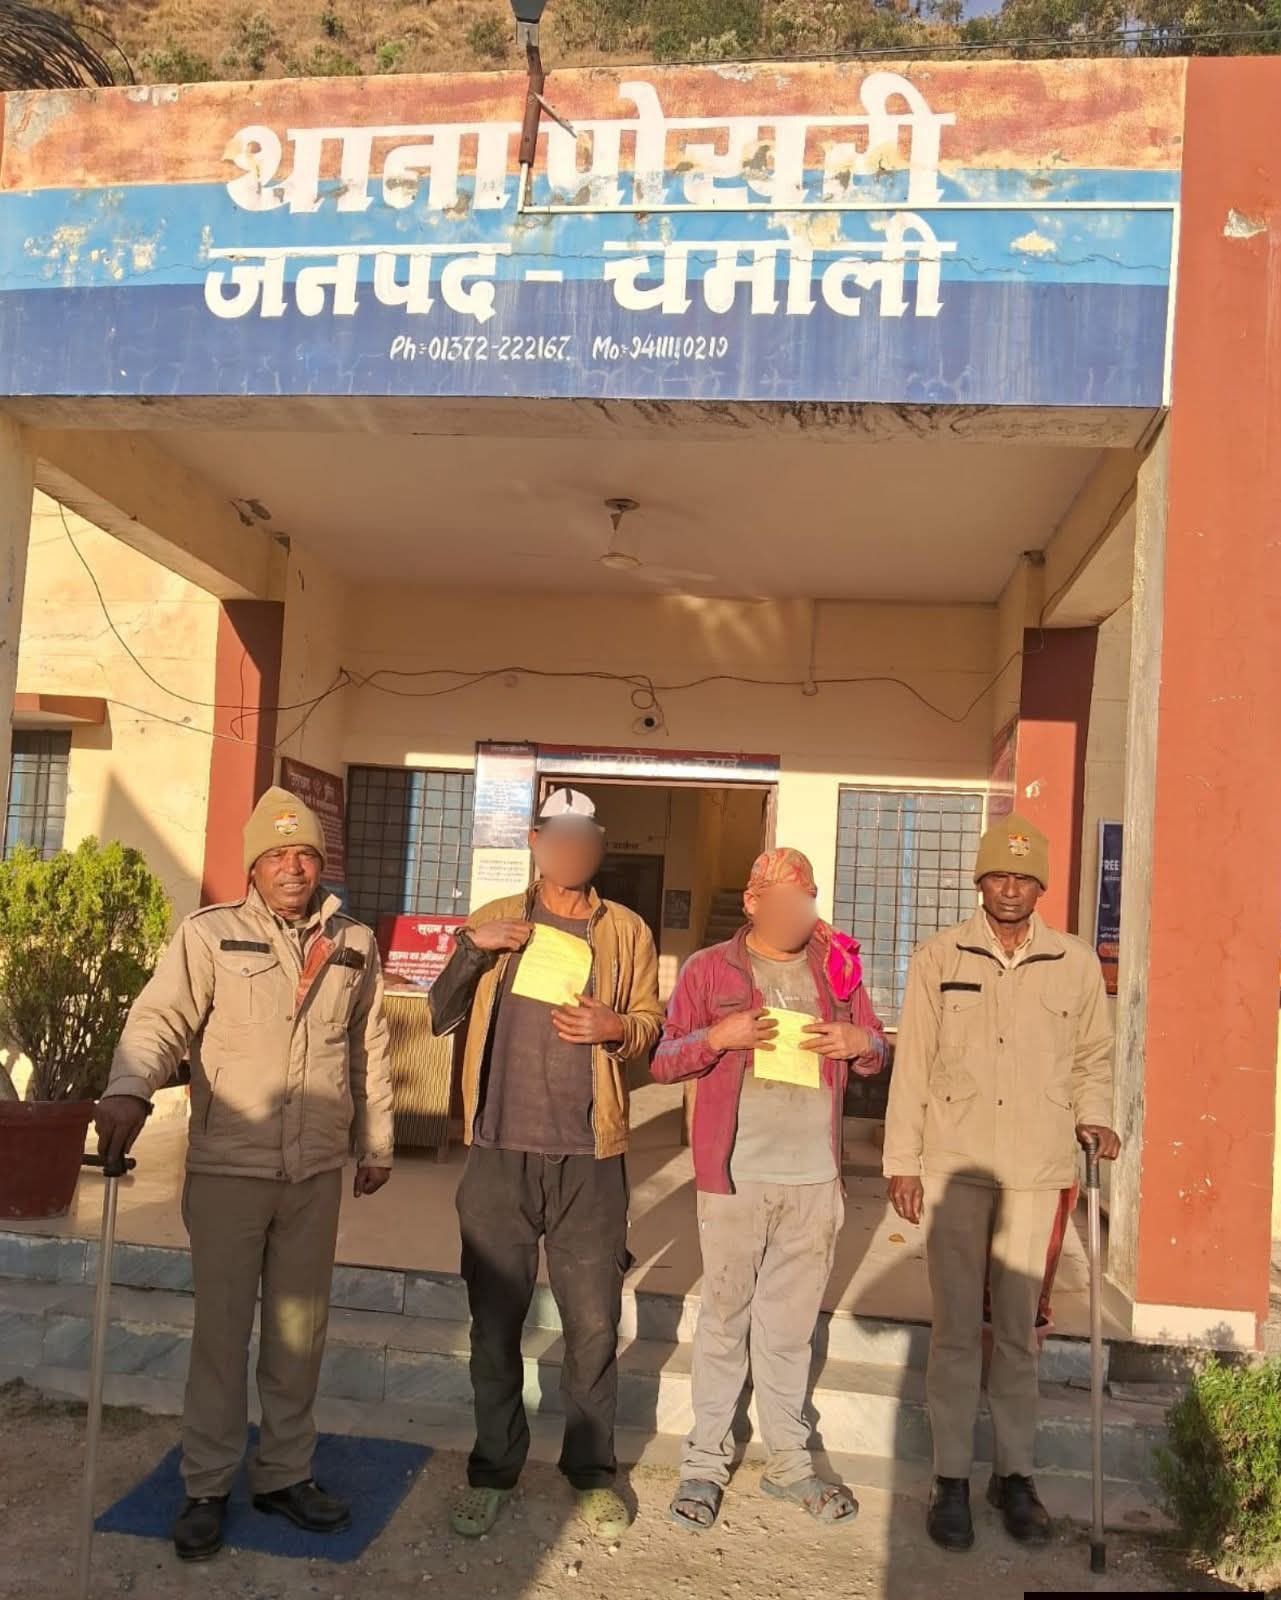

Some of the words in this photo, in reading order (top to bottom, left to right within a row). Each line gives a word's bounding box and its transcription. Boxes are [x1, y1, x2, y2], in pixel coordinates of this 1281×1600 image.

[221, 124, 518, 214] थाना
[538, 72, 956, 206] पोखरी
[203, 242, 512, 321] जनपद
[603, 211, 956, 319] चमोली
